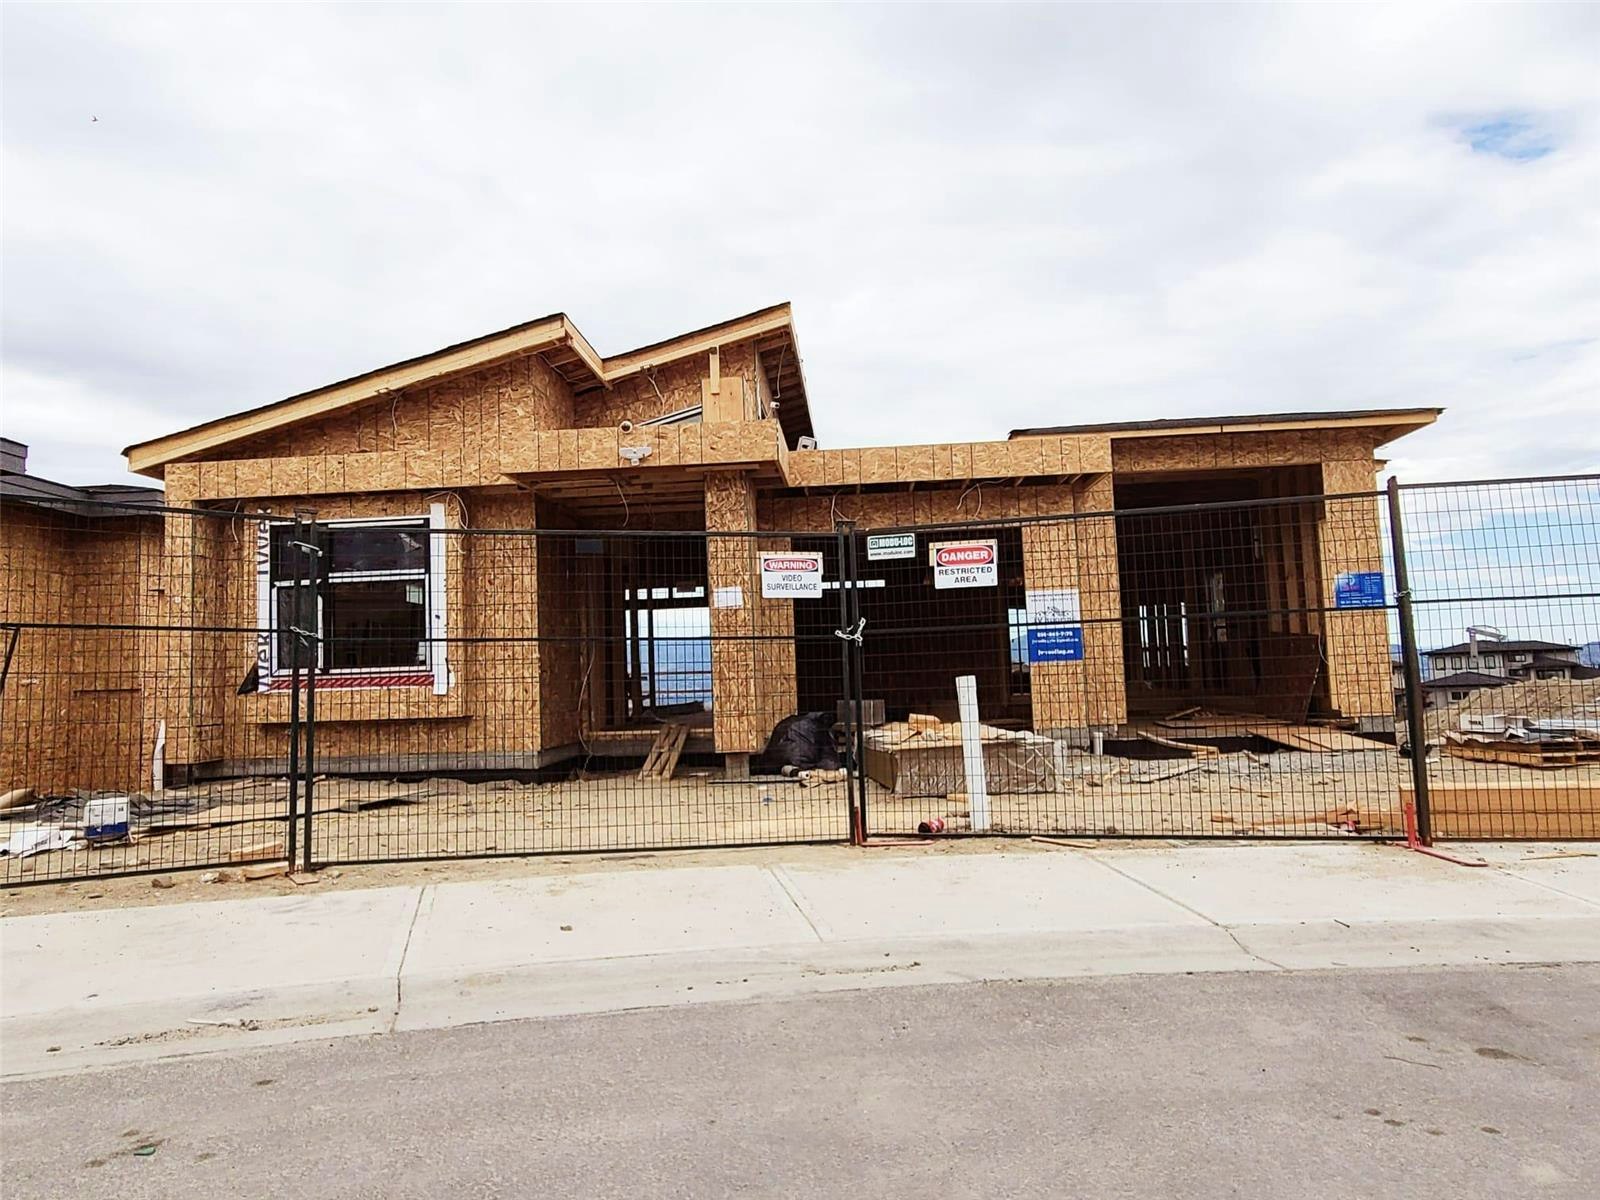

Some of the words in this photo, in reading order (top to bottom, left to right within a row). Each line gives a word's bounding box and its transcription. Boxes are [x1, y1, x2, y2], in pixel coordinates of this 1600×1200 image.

[941, 550, 989, 562] DANGER
[768, 561, 813, 570] WARNING
[938, 566, 993, 576] RESTRICTED
[781, 574, 803, 582] VIDEO
[954, 575, 978, 584] AREA
[766, 583, 818, 591] SURVEILLANCE
